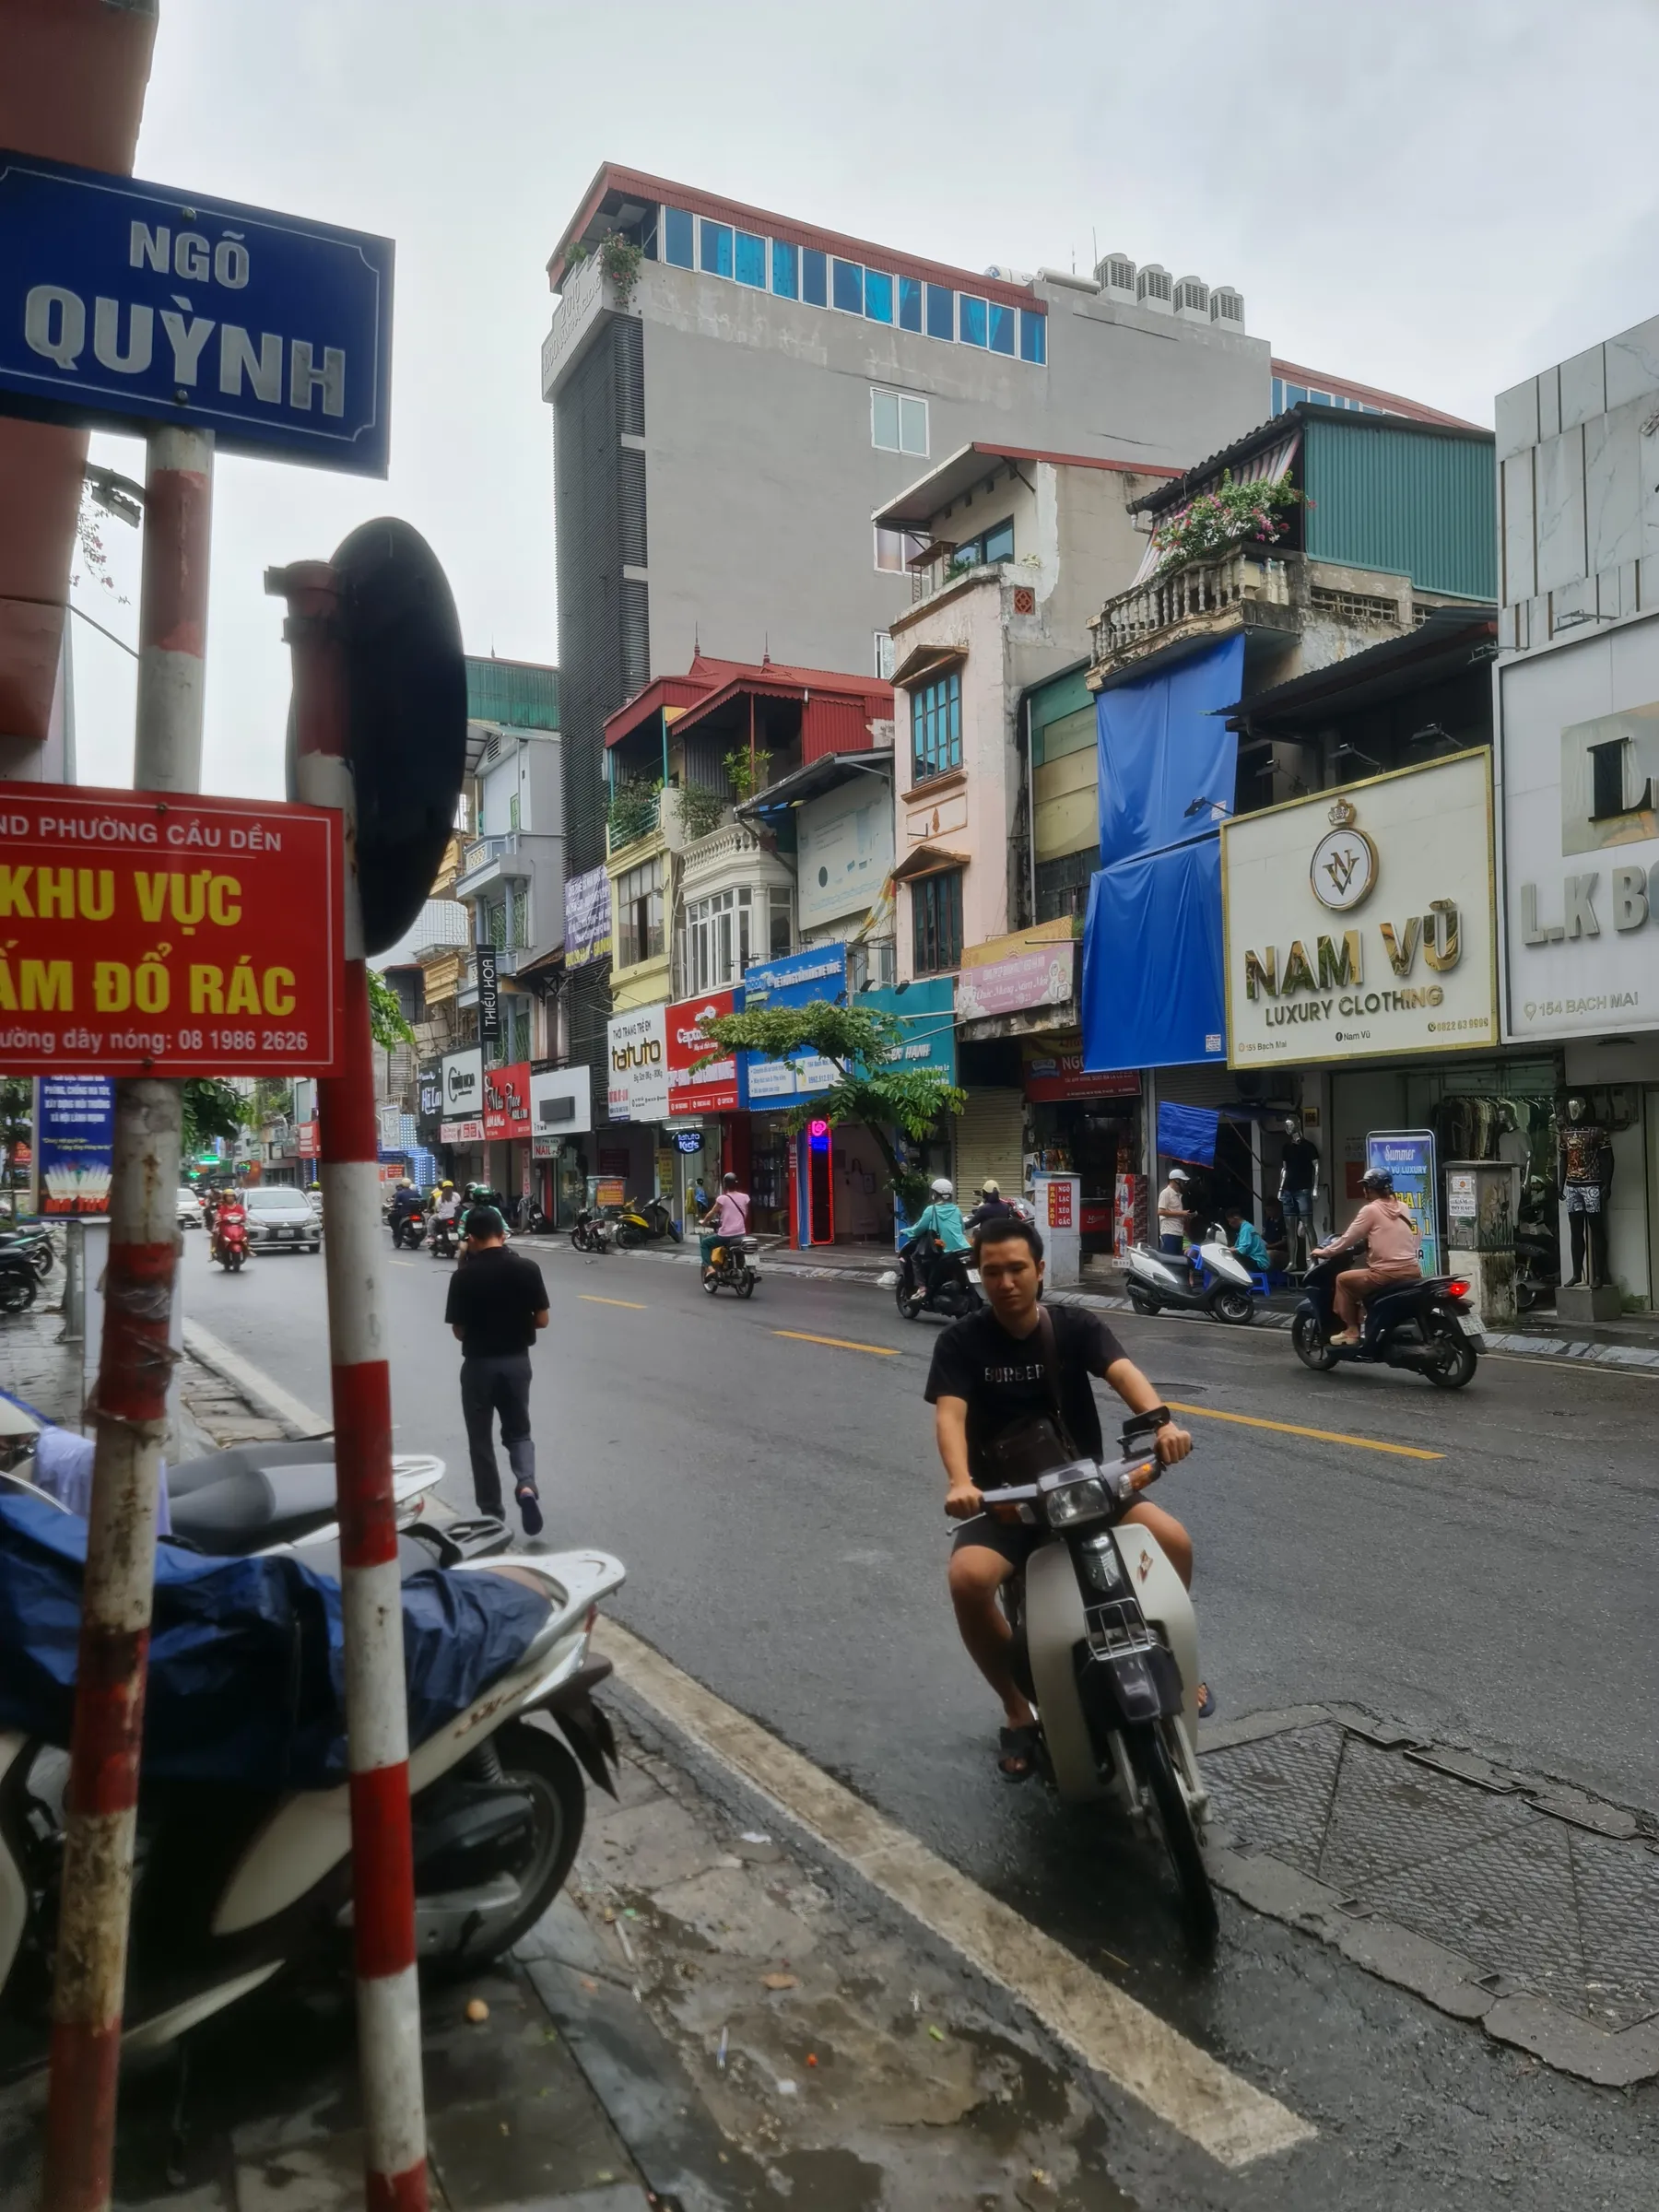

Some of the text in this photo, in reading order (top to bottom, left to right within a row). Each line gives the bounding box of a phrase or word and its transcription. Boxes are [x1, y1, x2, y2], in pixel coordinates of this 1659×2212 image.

[129, 220, 250, 290] NGÕ
[25, 285, 346, 418] QUỲNH
[39, 816, 158, 843] PHƯỜNG
[167, 819, 221, 847] CẦU
[0, 865, 242, 935] KHU VỰC
[1245, 898, 1463, 1000] NAM VŨ
[92, 942, 170, 1013] ĐỔ
[190, 955, 296, 1016] RÁC
[482, 959, 495, 988] HOA
[1265, 984, 1444, 1027] LUXURY CLOTHING
[1538, 991, 1639, 1016] 154 BẠCH MAI
[111, 1030, 171, 1054] nóng:
[179, 1030, 203, 1050] 08
[211, 1031, 256, 1050] 1986
[263, 1032, 308, 1051] 2626
[1257, 1042, 1274, 1053] Bạch
[1276, 1041, 1288, 1049] Mai
[1344, 1030, 1371, 1041] Nam Vũ
[612, 1037, 661, 1072] tatuto
[1062, 1054, 1085, 1071] NG
[1385, 1145, 1415, 1161] Summer
[1401, 1165, 1427, 1175] LUXURY
